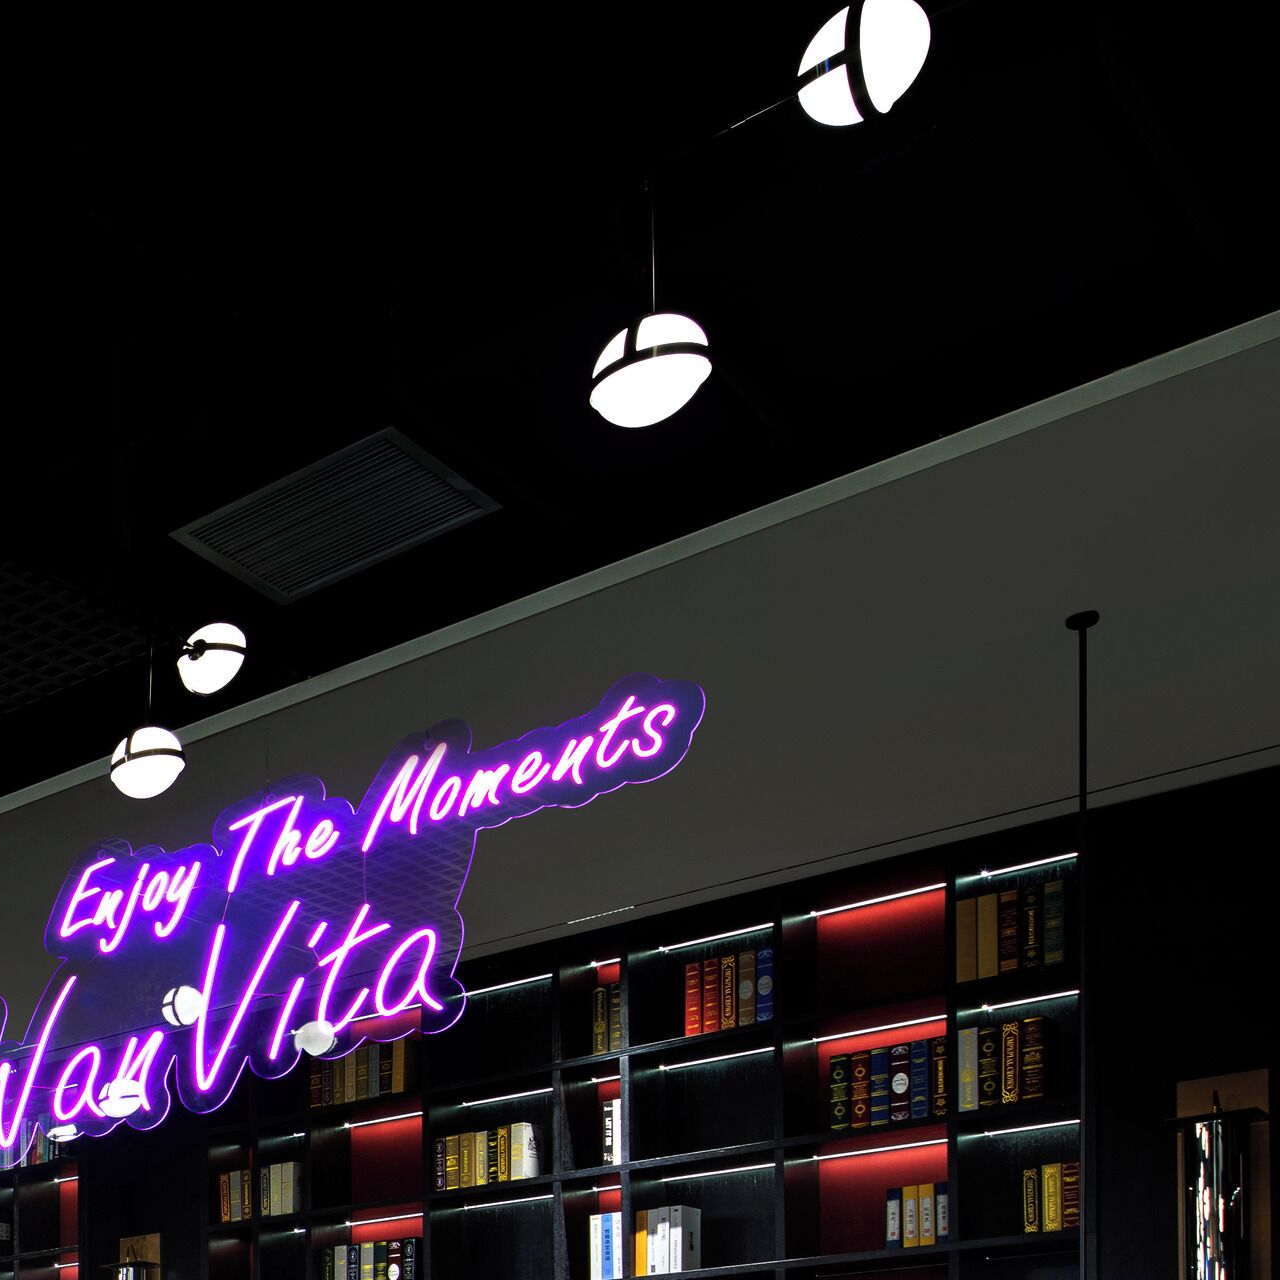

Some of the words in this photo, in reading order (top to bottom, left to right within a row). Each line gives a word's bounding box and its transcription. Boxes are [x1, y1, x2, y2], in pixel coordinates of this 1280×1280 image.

[58, 857, 203, 954] Enjoy
[226, 794, 341, 894] The
[359, 694, 678, 853] Moments
[192, 899, 445, 1093] Vita
